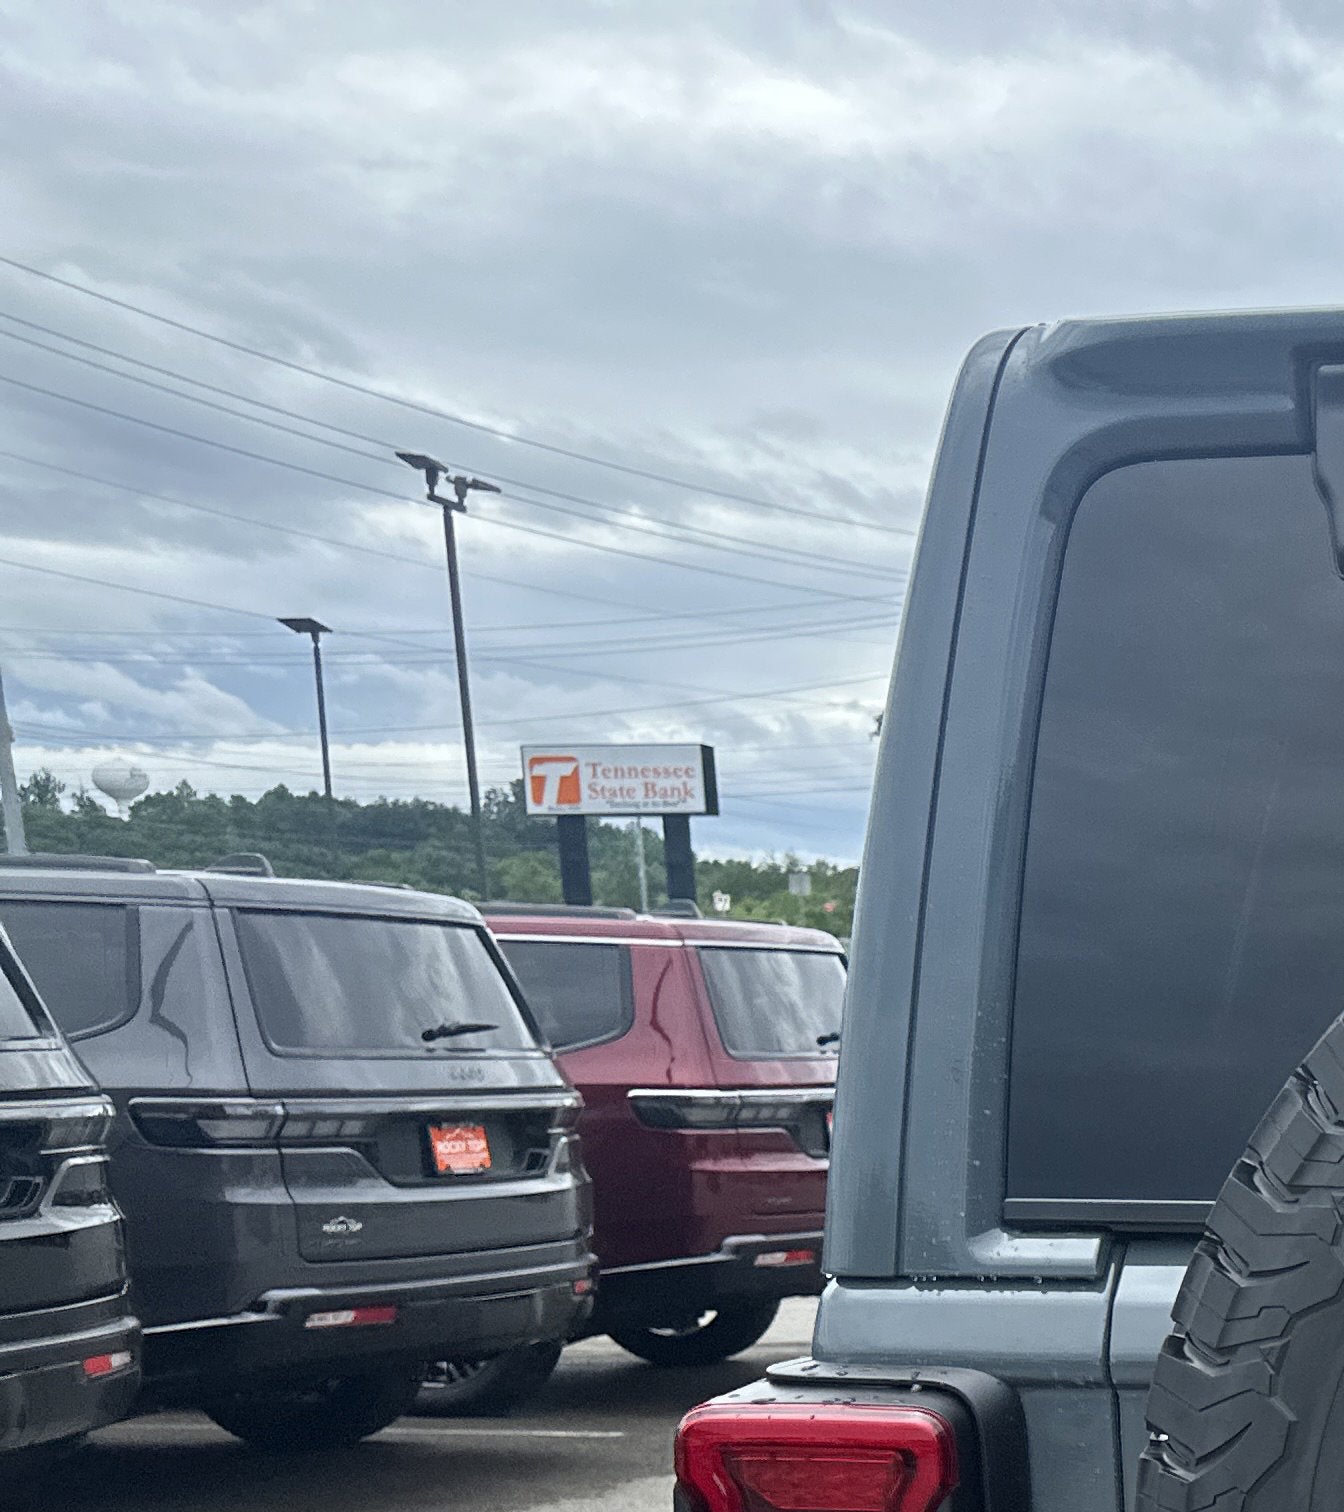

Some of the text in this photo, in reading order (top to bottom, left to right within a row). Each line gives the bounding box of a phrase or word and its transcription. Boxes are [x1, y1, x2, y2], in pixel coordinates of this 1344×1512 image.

[586, 762, 696, 779] Tennessee
[588, 781, 696, 799] State Bank
